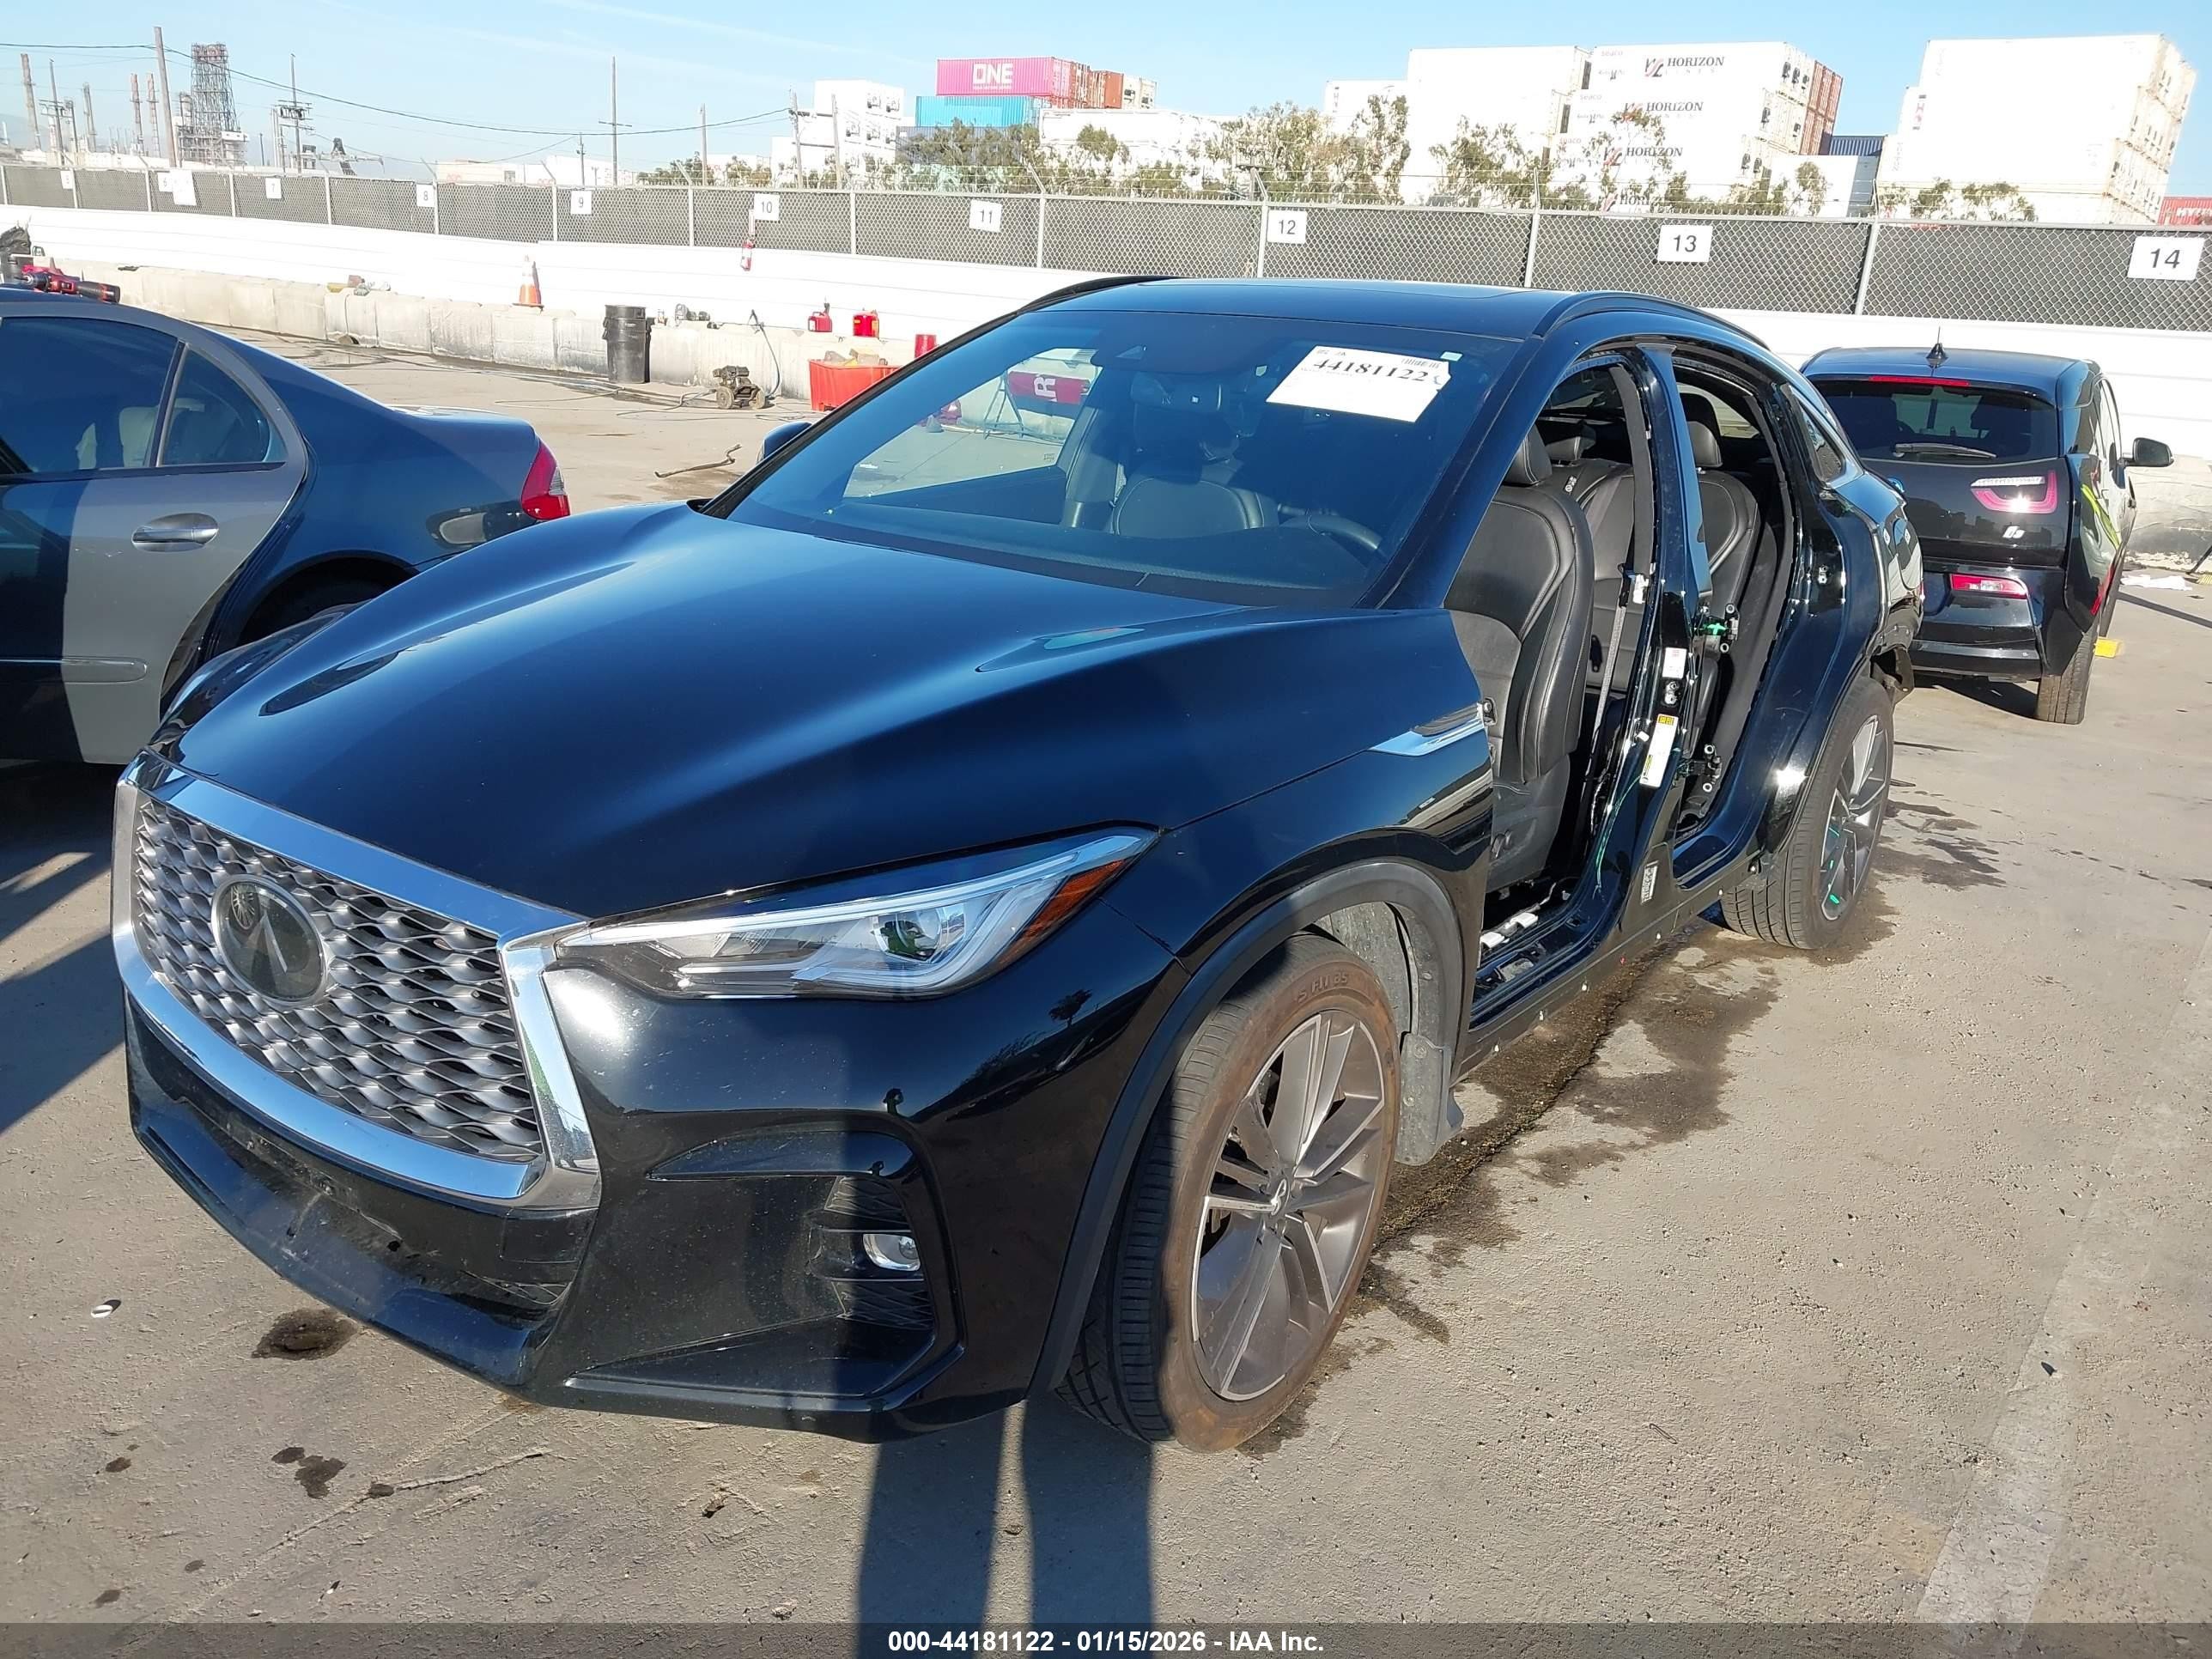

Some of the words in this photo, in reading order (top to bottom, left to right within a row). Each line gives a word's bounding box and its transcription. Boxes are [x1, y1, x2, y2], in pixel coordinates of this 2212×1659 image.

[1667, 56, 1725, 67] HORIZON
[972, 62, 1013, 85] ONE
[1645, 101, 1704, 112] HORIZON
[1626, 147, 1683, 157] HORIZON
[423, 191, 428, 201] 8
[578, 197, 584, 208] 9
[761, 201, 773, 214] 10
[980, 210, 994, 223] 11
[1278, 220, 1296, 235] 12
[1673, 235, 1698, 253] 13
[2150, 248, 2180, 269] 14
[1314, 357, 1429, 382] 44181122
